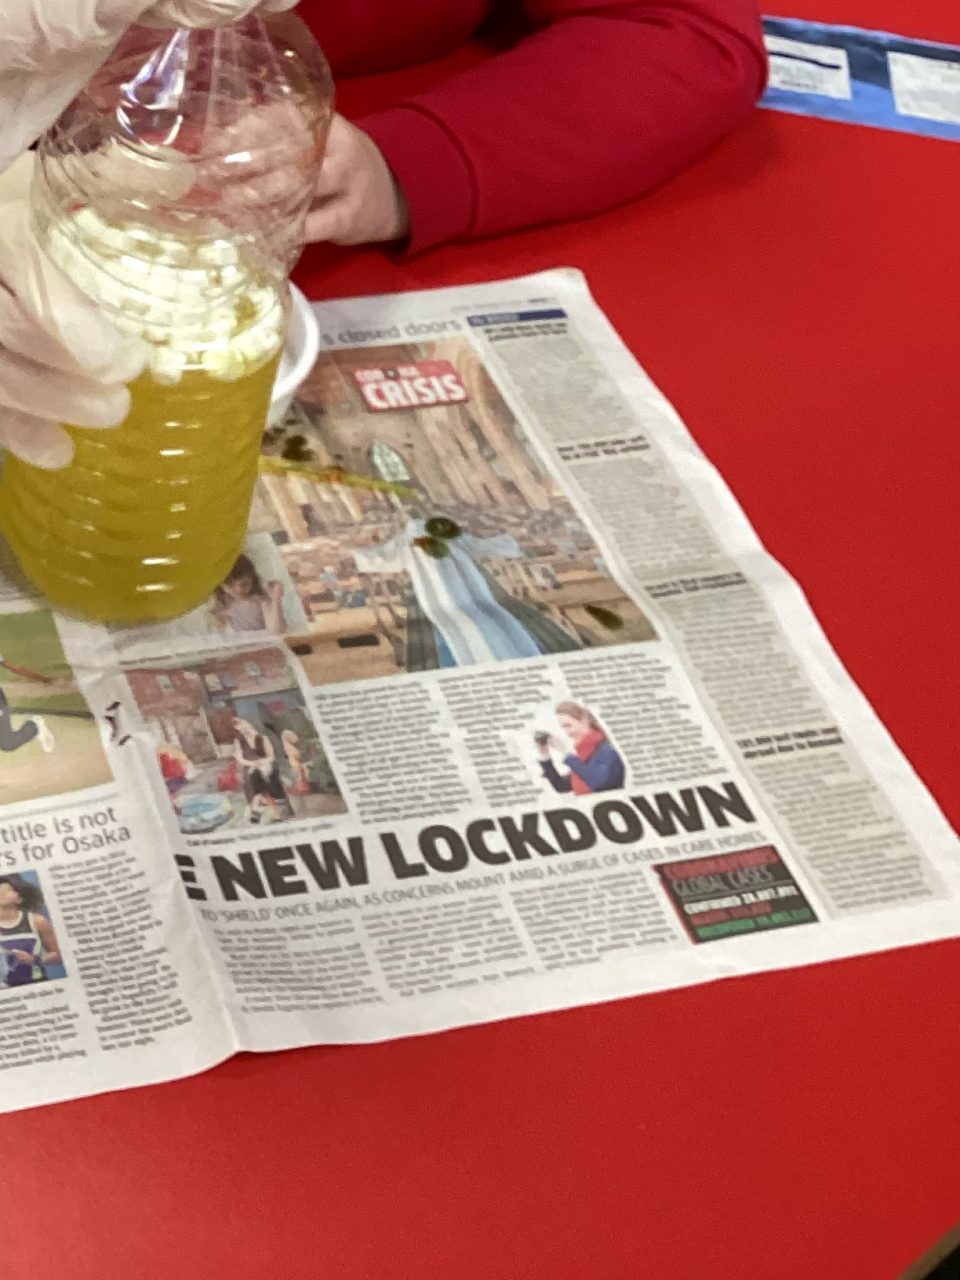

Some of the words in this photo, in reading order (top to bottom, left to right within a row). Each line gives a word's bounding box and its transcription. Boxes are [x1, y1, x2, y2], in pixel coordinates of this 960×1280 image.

[337, 326, 401, 344] closed
[404, 319, 463, 336] doors
[362, 373, 466, 409] CRISIS
[1, 821, 47, 843] title
[52, 816, 73, 834] is
[80, 807, 118, 829] not
[210, 835, 370, 902] NEW
[379, 780, 757, 880] LOCKDOWN
[22, 843, 55, 862] for
[62, 826, 131, 855] Osaka
[275, 902, 311, 919] ONCE
[364, 892, 382, 907] AS
[382, 880, 455, 904] CONCERNS
[456, 873, 506, 895] MOUNT
[509, 868, 545, 883] AMID
[547, 864, 558, 878] A
[559, 857, 602, 875] SURGE
[603, 852, 620, 867] OF
[622, 847, 666, 865] CASES
[666, 843, 681, 856] IN
[682, 837, 716, 853] CARE
[727, 864, 773, 889] CASES
